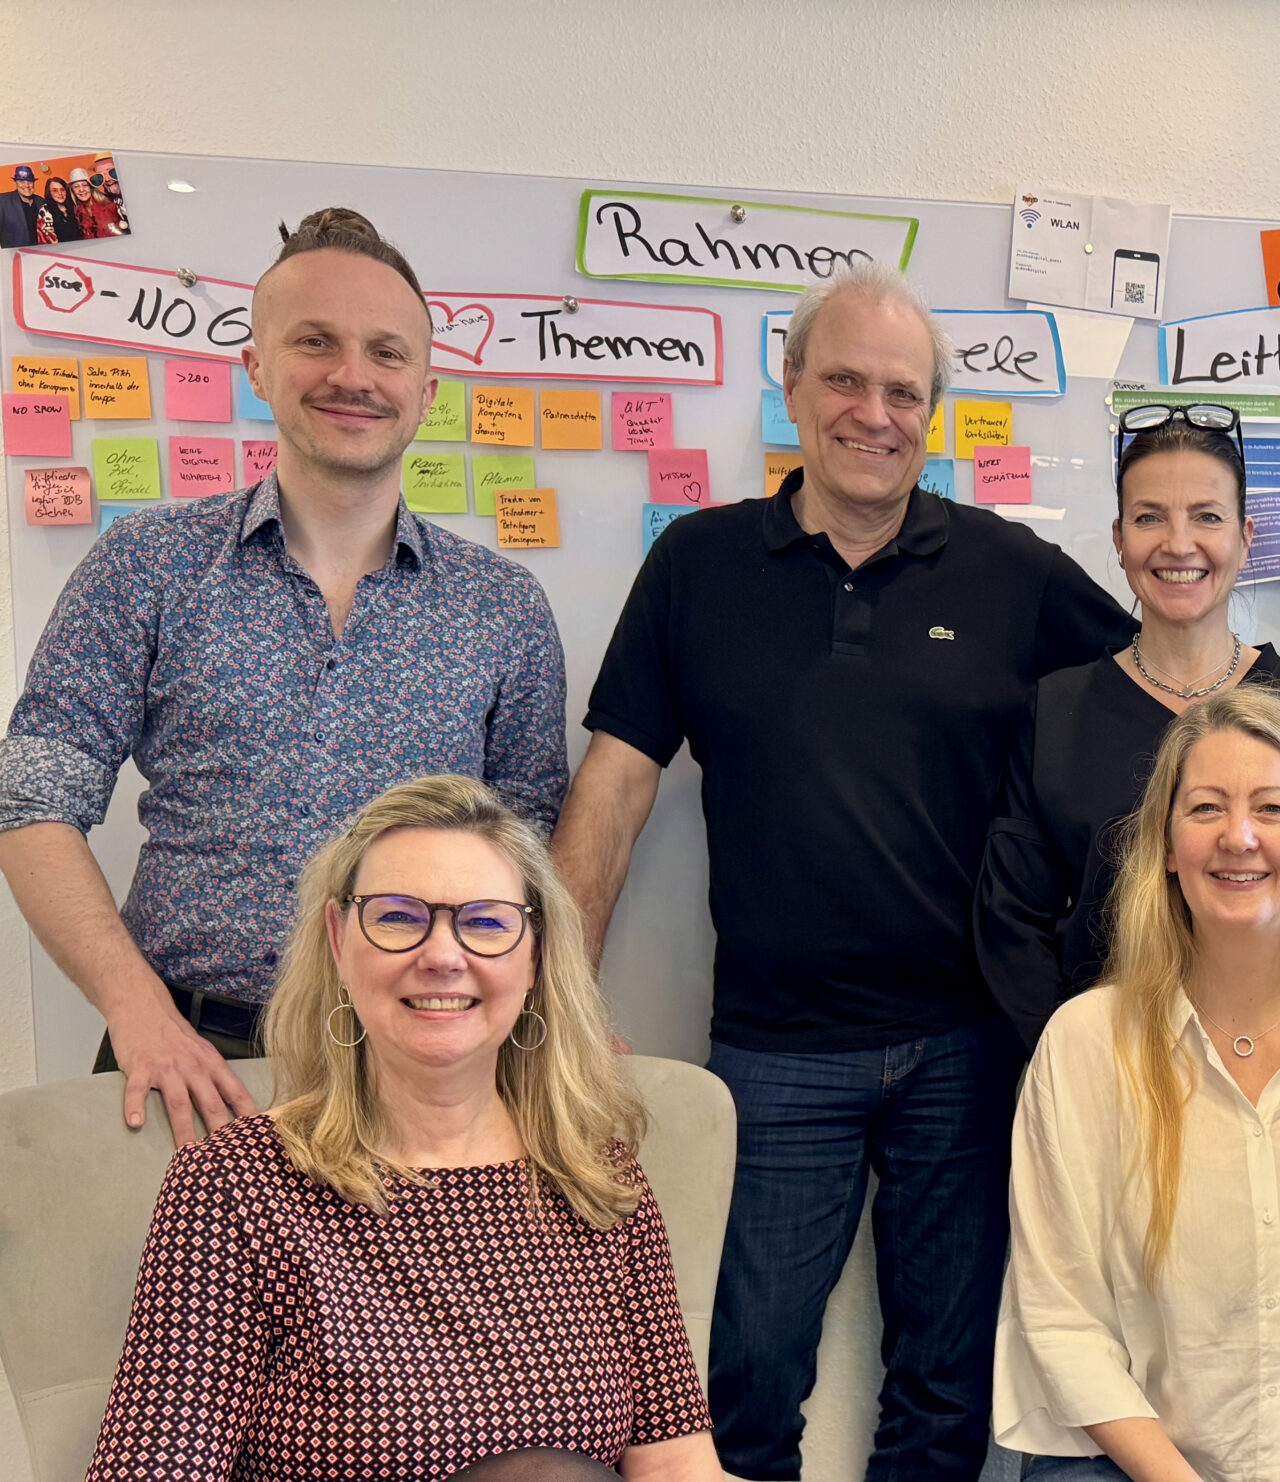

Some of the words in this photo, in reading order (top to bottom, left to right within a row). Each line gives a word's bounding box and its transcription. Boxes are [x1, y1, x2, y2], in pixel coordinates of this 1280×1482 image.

[1051, 218, 1079, 230] WLAN
[45, 276, 83, 292] STOP
[128, 287, 196, 337] NO
[521, 310, 704, 366] Themen
[89, 380, 123, 390] innerhalb
[476, 394, 514, 408] Digitale
[12, 406, 28, 414] NO
[34, 405, 62, 414] SHOW
[478, 407, 523, 421] Kompetenz
[106, 449, 143, 464] Ohne
[480, 472, 524, 486] Alumni
